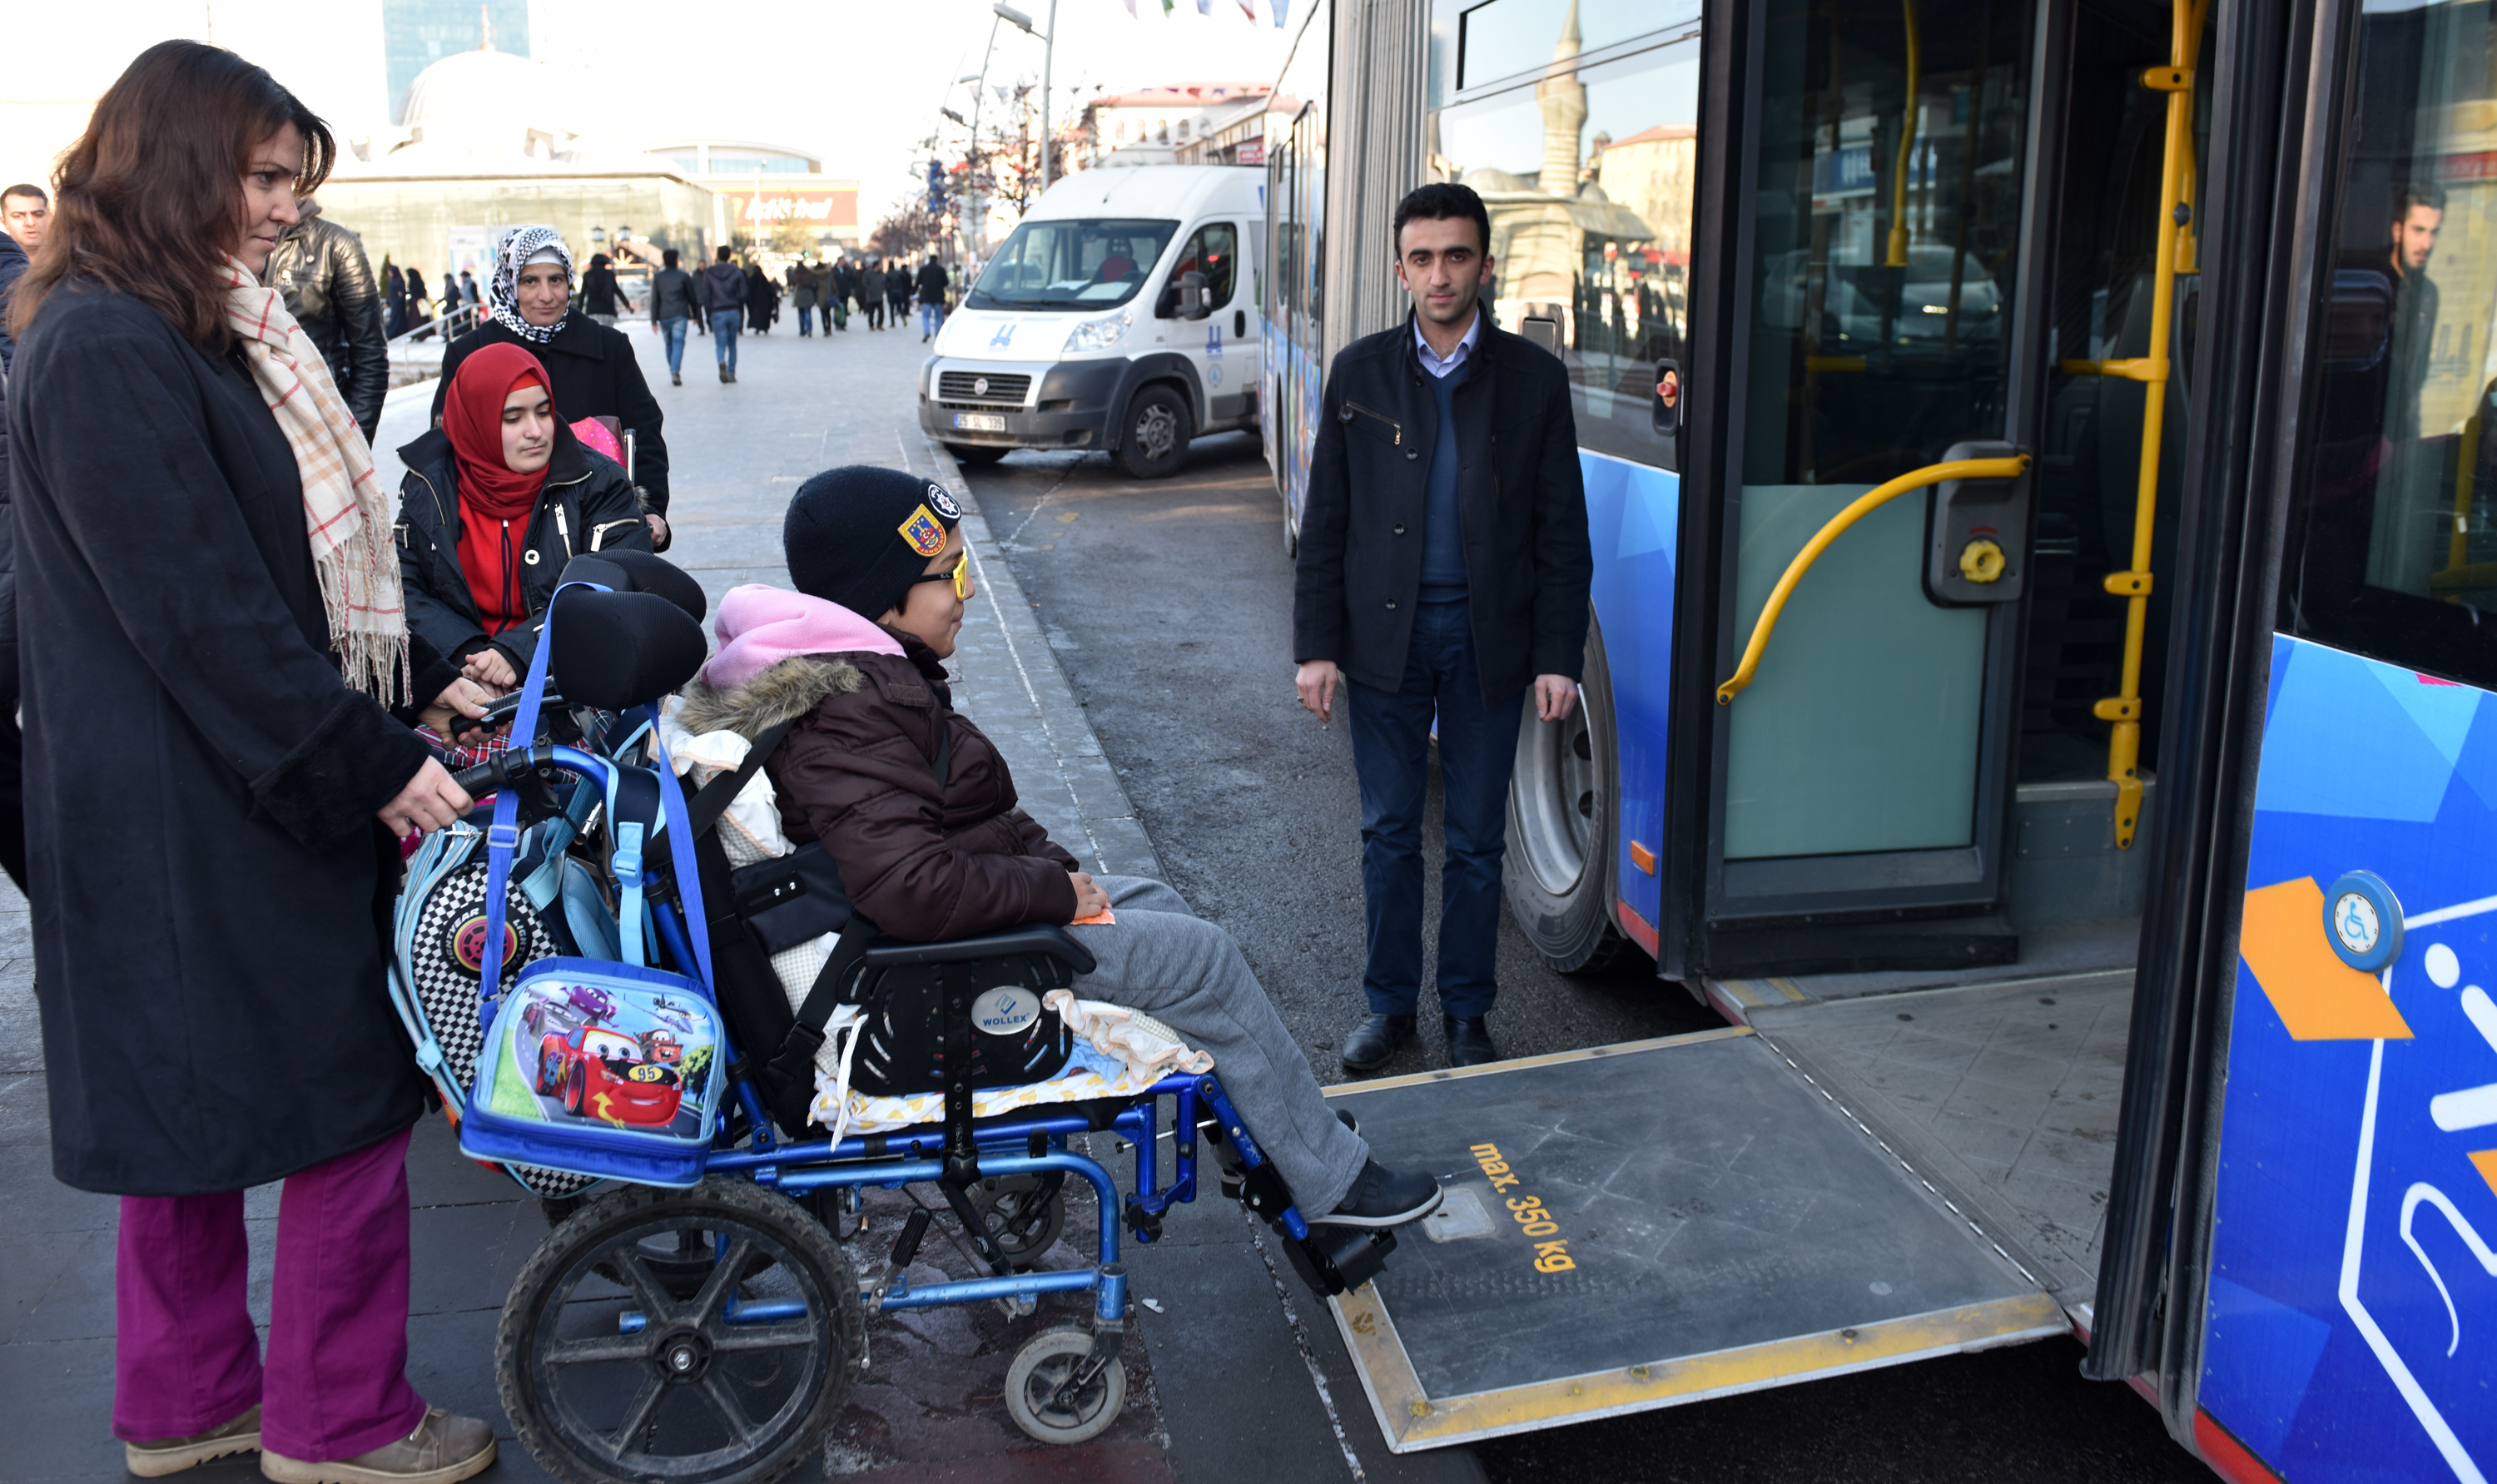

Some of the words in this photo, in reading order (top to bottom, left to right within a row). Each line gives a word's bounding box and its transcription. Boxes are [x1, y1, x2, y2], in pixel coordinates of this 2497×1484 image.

[920, 529, 944, 553] JANDARMA
[983, 1015, 1027, 1026] WOLLEX
[638, 1066, 656, 1082] 95
[1470, 1143, 1520, 1194] max.
[1506, 1195, 1559, 1237] 350
[1533, 1239, 1576, 1273] kg
